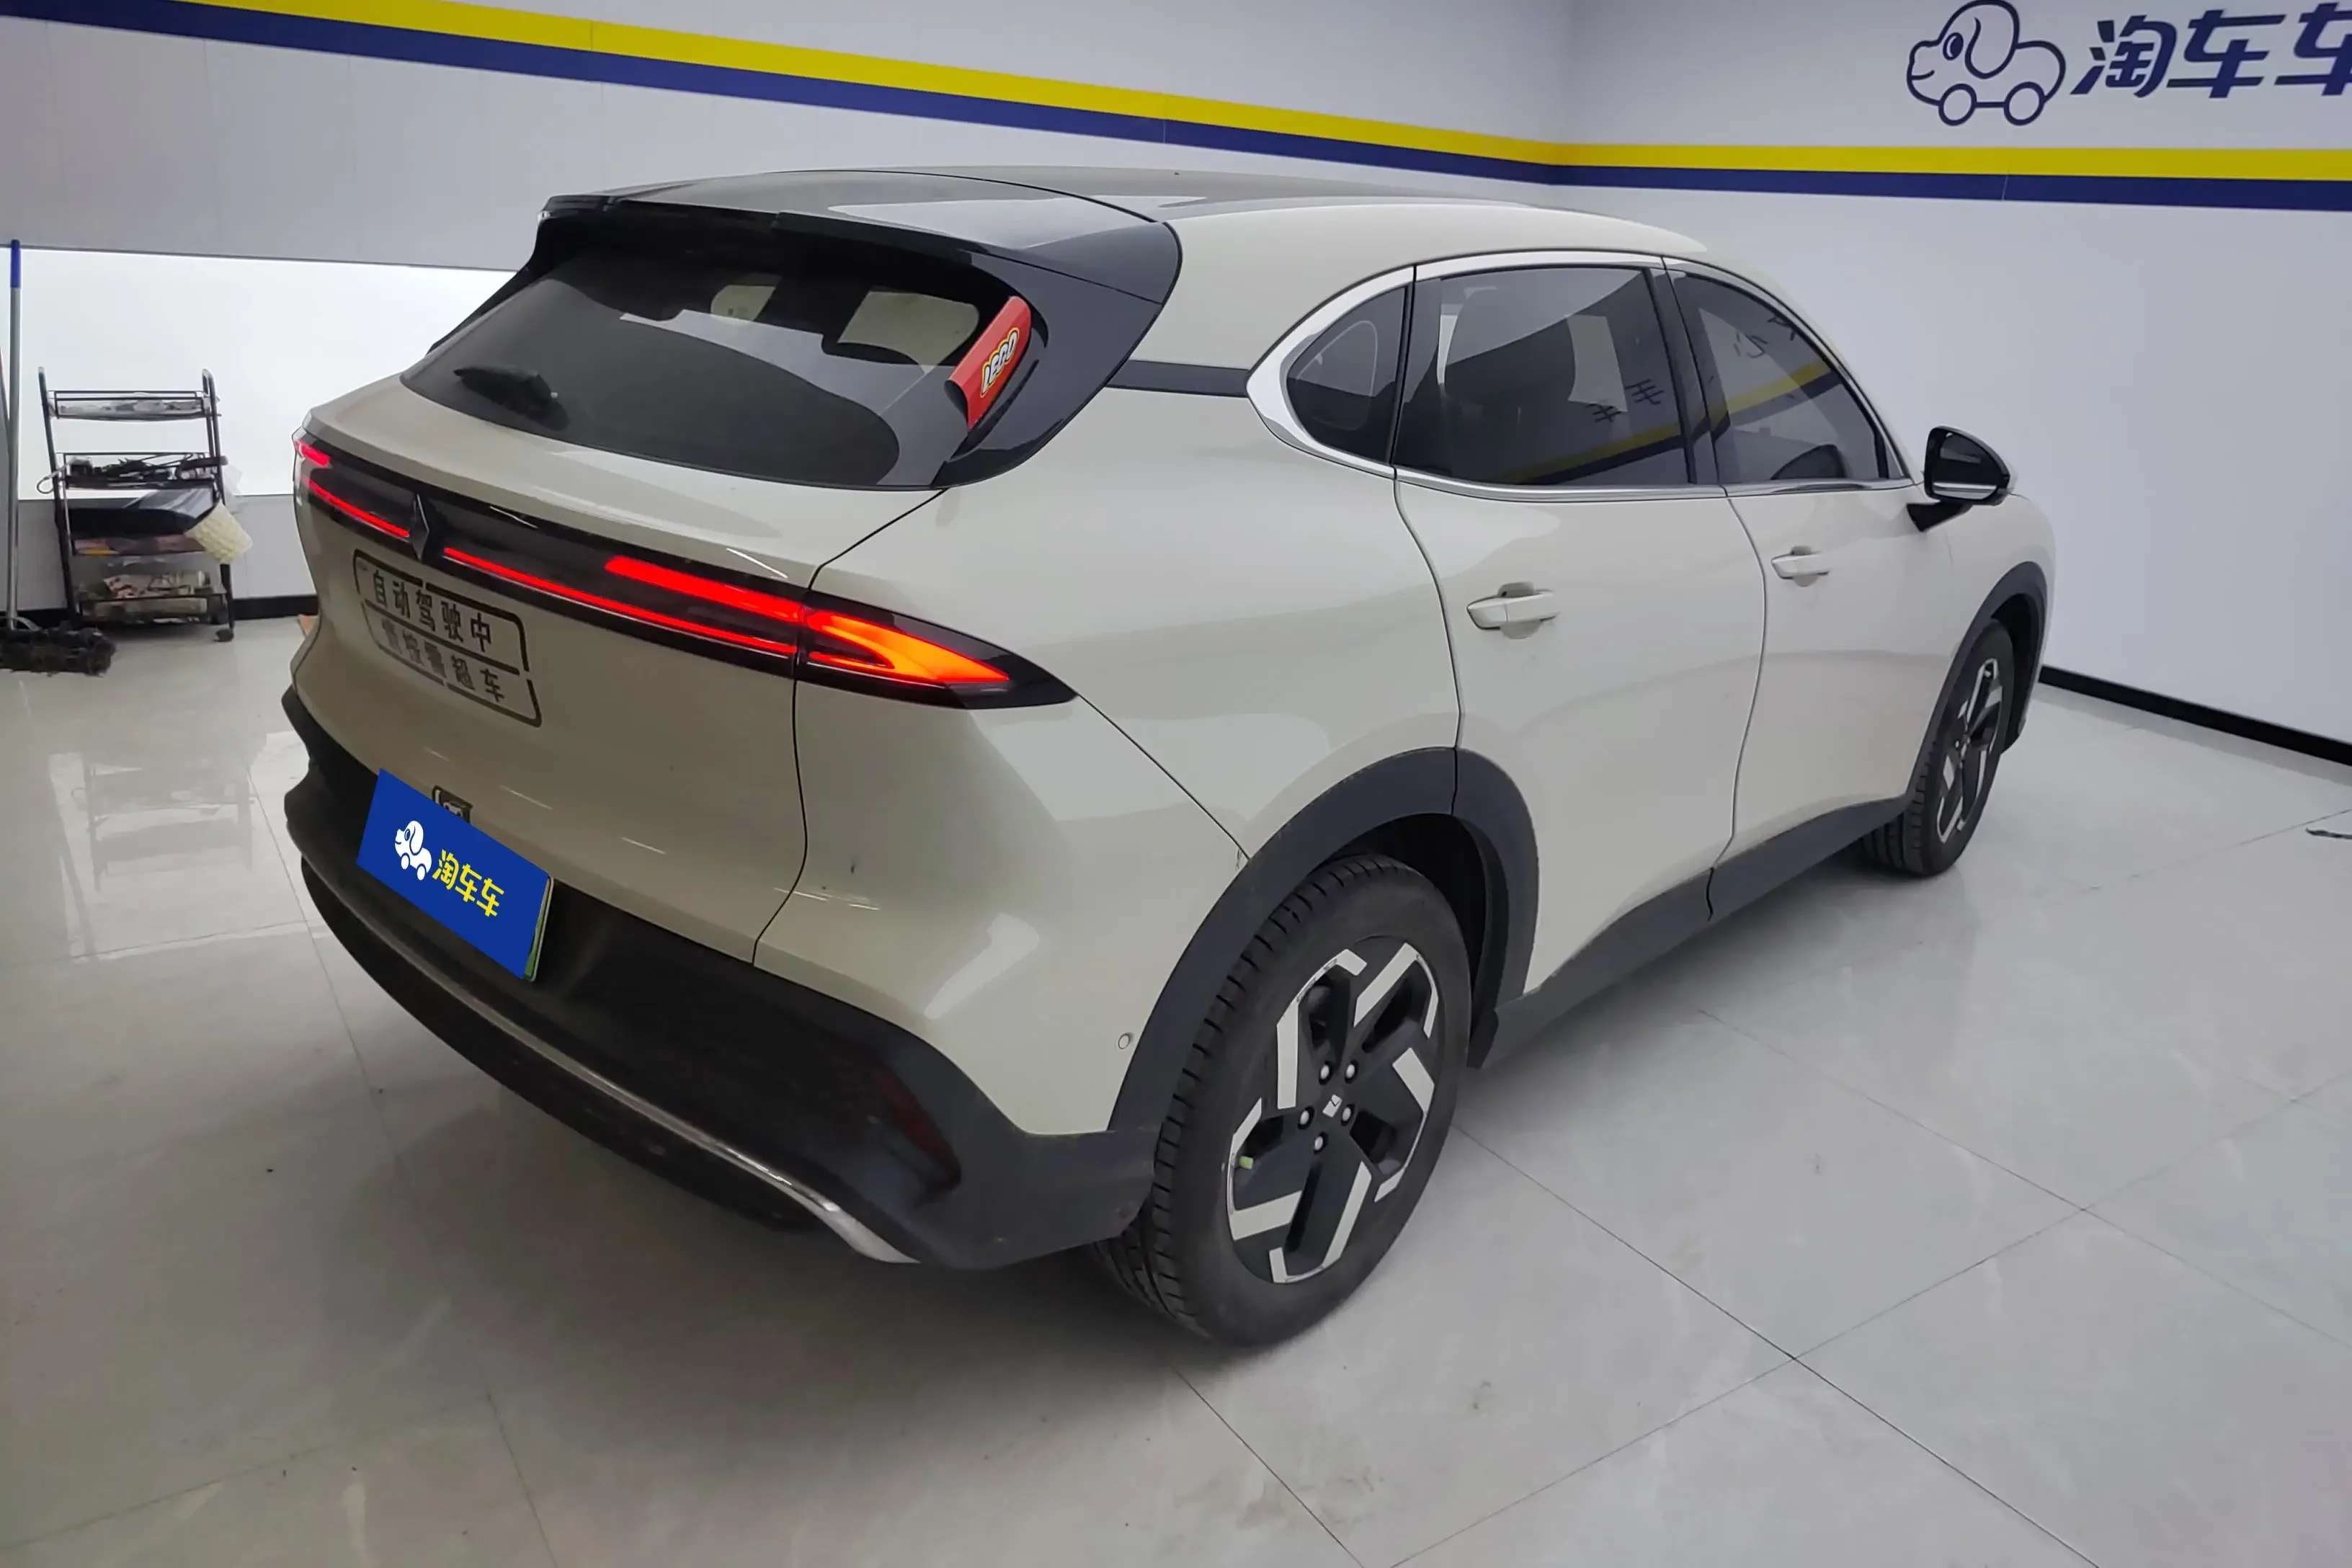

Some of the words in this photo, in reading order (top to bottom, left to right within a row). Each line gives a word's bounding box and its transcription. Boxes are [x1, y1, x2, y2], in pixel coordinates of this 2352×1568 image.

[981, 328, 1020, 397] LEGO
[373, 569, 491, 652] 自动驾驶中
